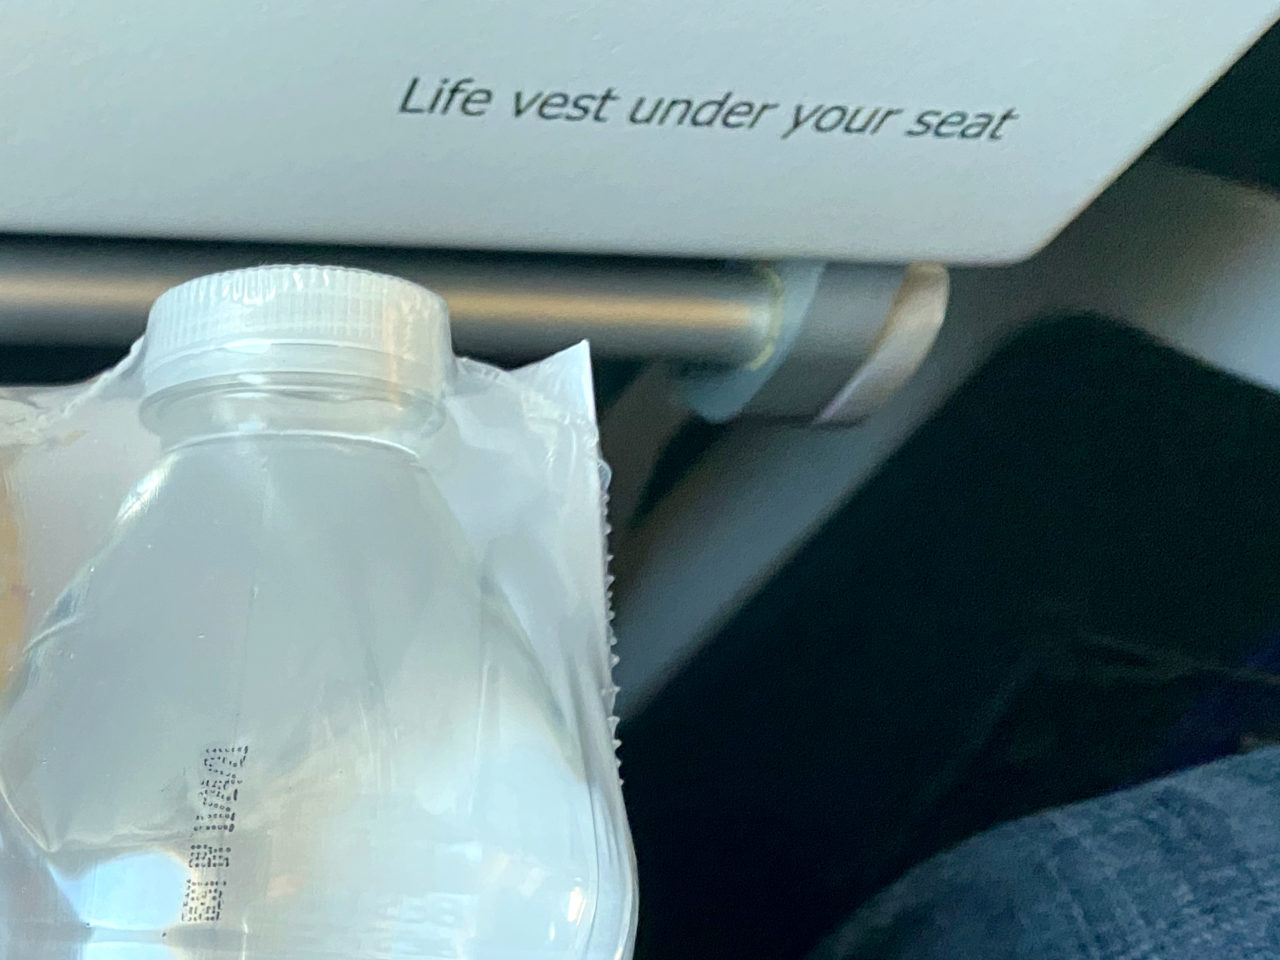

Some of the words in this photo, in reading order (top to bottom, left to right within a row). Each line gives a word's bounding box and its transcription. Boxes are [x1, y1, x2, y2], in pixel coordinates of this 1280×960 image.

[398, 77, 492, 117] Life
[512, 87, 617, 124] vest
[629, 92, 778, 129] under
[780, 101, 903, 139] your
[906, 107, 1017, 140] seat
